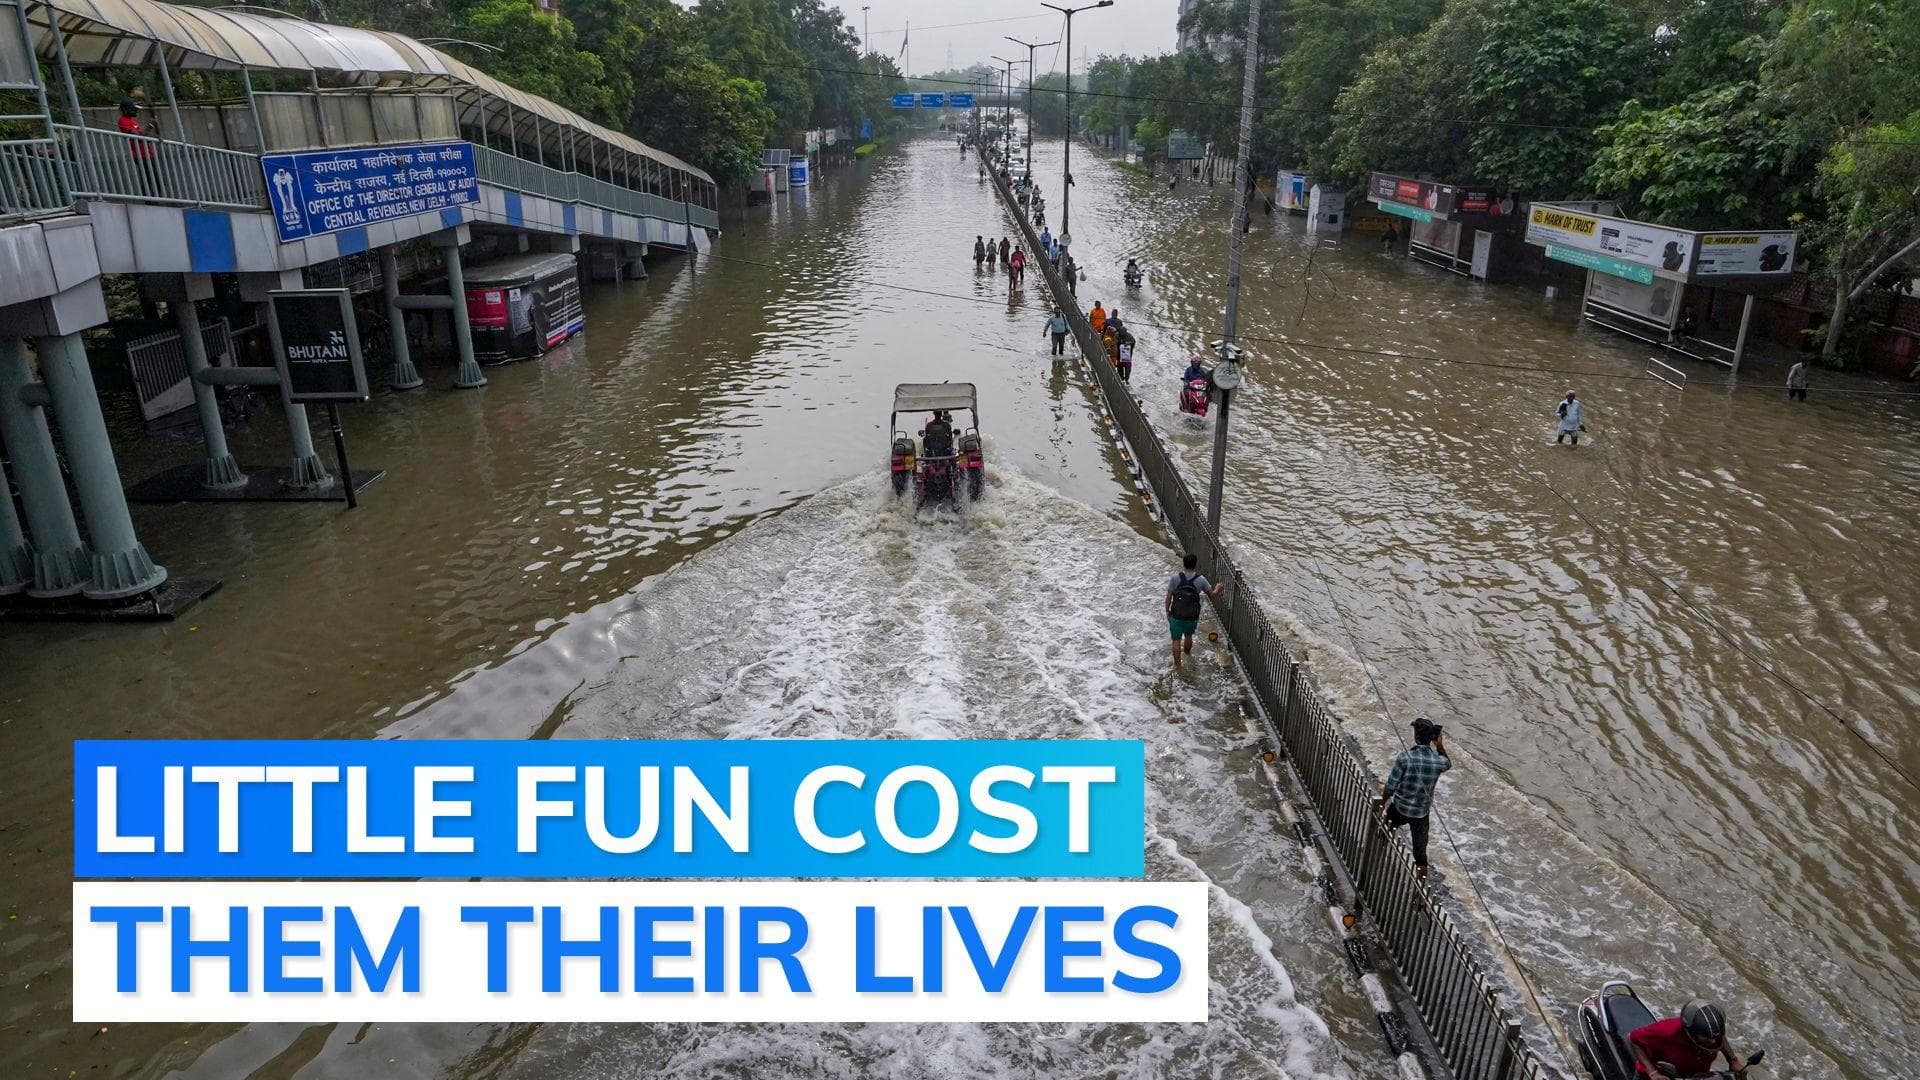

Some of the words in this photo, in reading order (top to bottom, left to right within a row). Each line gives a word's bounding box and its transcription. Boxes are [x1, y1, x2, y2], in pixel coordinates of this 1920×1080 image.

[311, 156, 358, 173] कार्यालय
[417, 150, 437, 163] लेखा
[440, 147, 462, 160] परीक्षा
[314, 177, 352, 195] केन्द्रीय
[392, 169, 406, 185] नई
[308, 197, 341, 215] OFFICE
[343, 194, 355, 208] OF
[357, 191, 375, 205] THE
[376, 184, 414, 203] DIRECTOR
[415, 181, 447, 197] GENERAL
[448, 179, 457, 191] OF
[458, 177, 476, 190] AUDIT
[324, 209, 366, 229] CENTRAL
[409, 197, 426, 213] NEW
[427, 193, 446, 209] DELHI
[1543, 211, 1563, 227] MARK
[1562, 215, 1573, 229] OF
[1573, 218, 1596, 234] TRUST
[288, 345, 347, 358] BHUTANI
